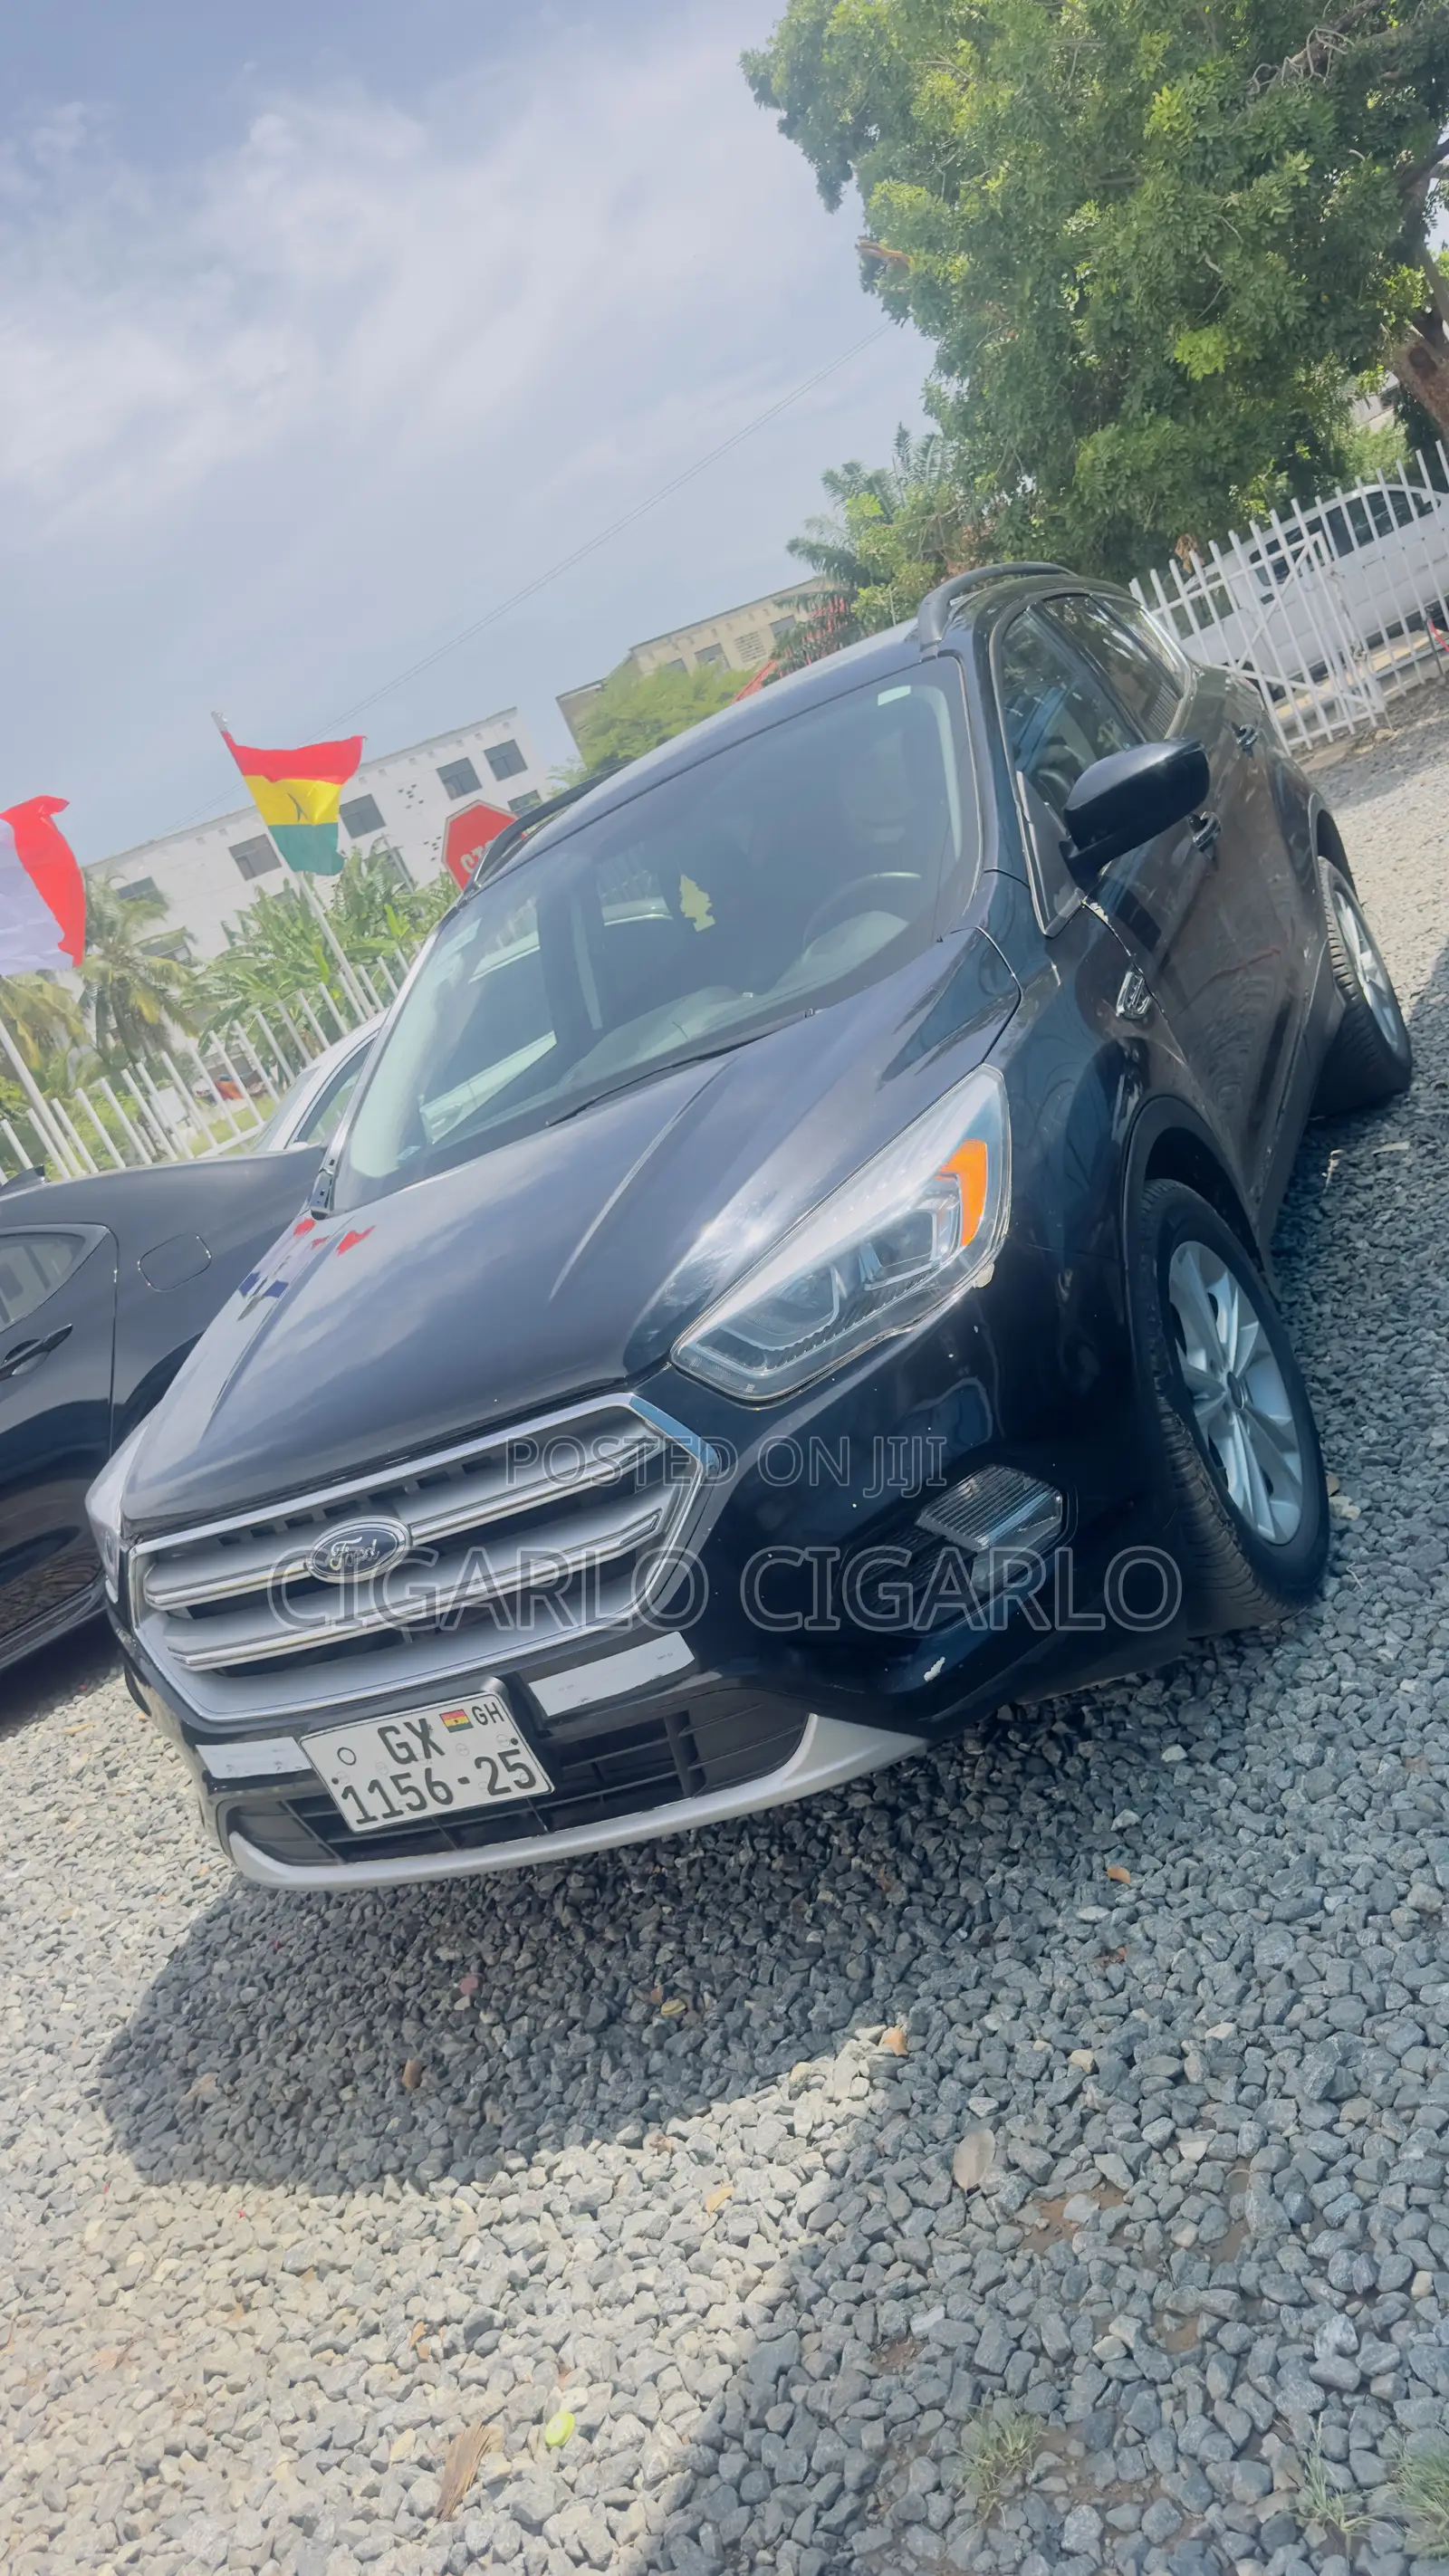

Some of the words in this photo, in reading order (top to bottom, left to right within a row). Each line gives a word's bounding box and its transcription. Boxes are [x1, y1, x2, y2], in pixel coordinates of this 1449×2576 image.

[329, 1536, 380, 1571] Ford
[471, 1701, 504, 1726] GH
[377, 1717, 445, 1765] GX
[341, 1748, 537, 1824] 1156-25
